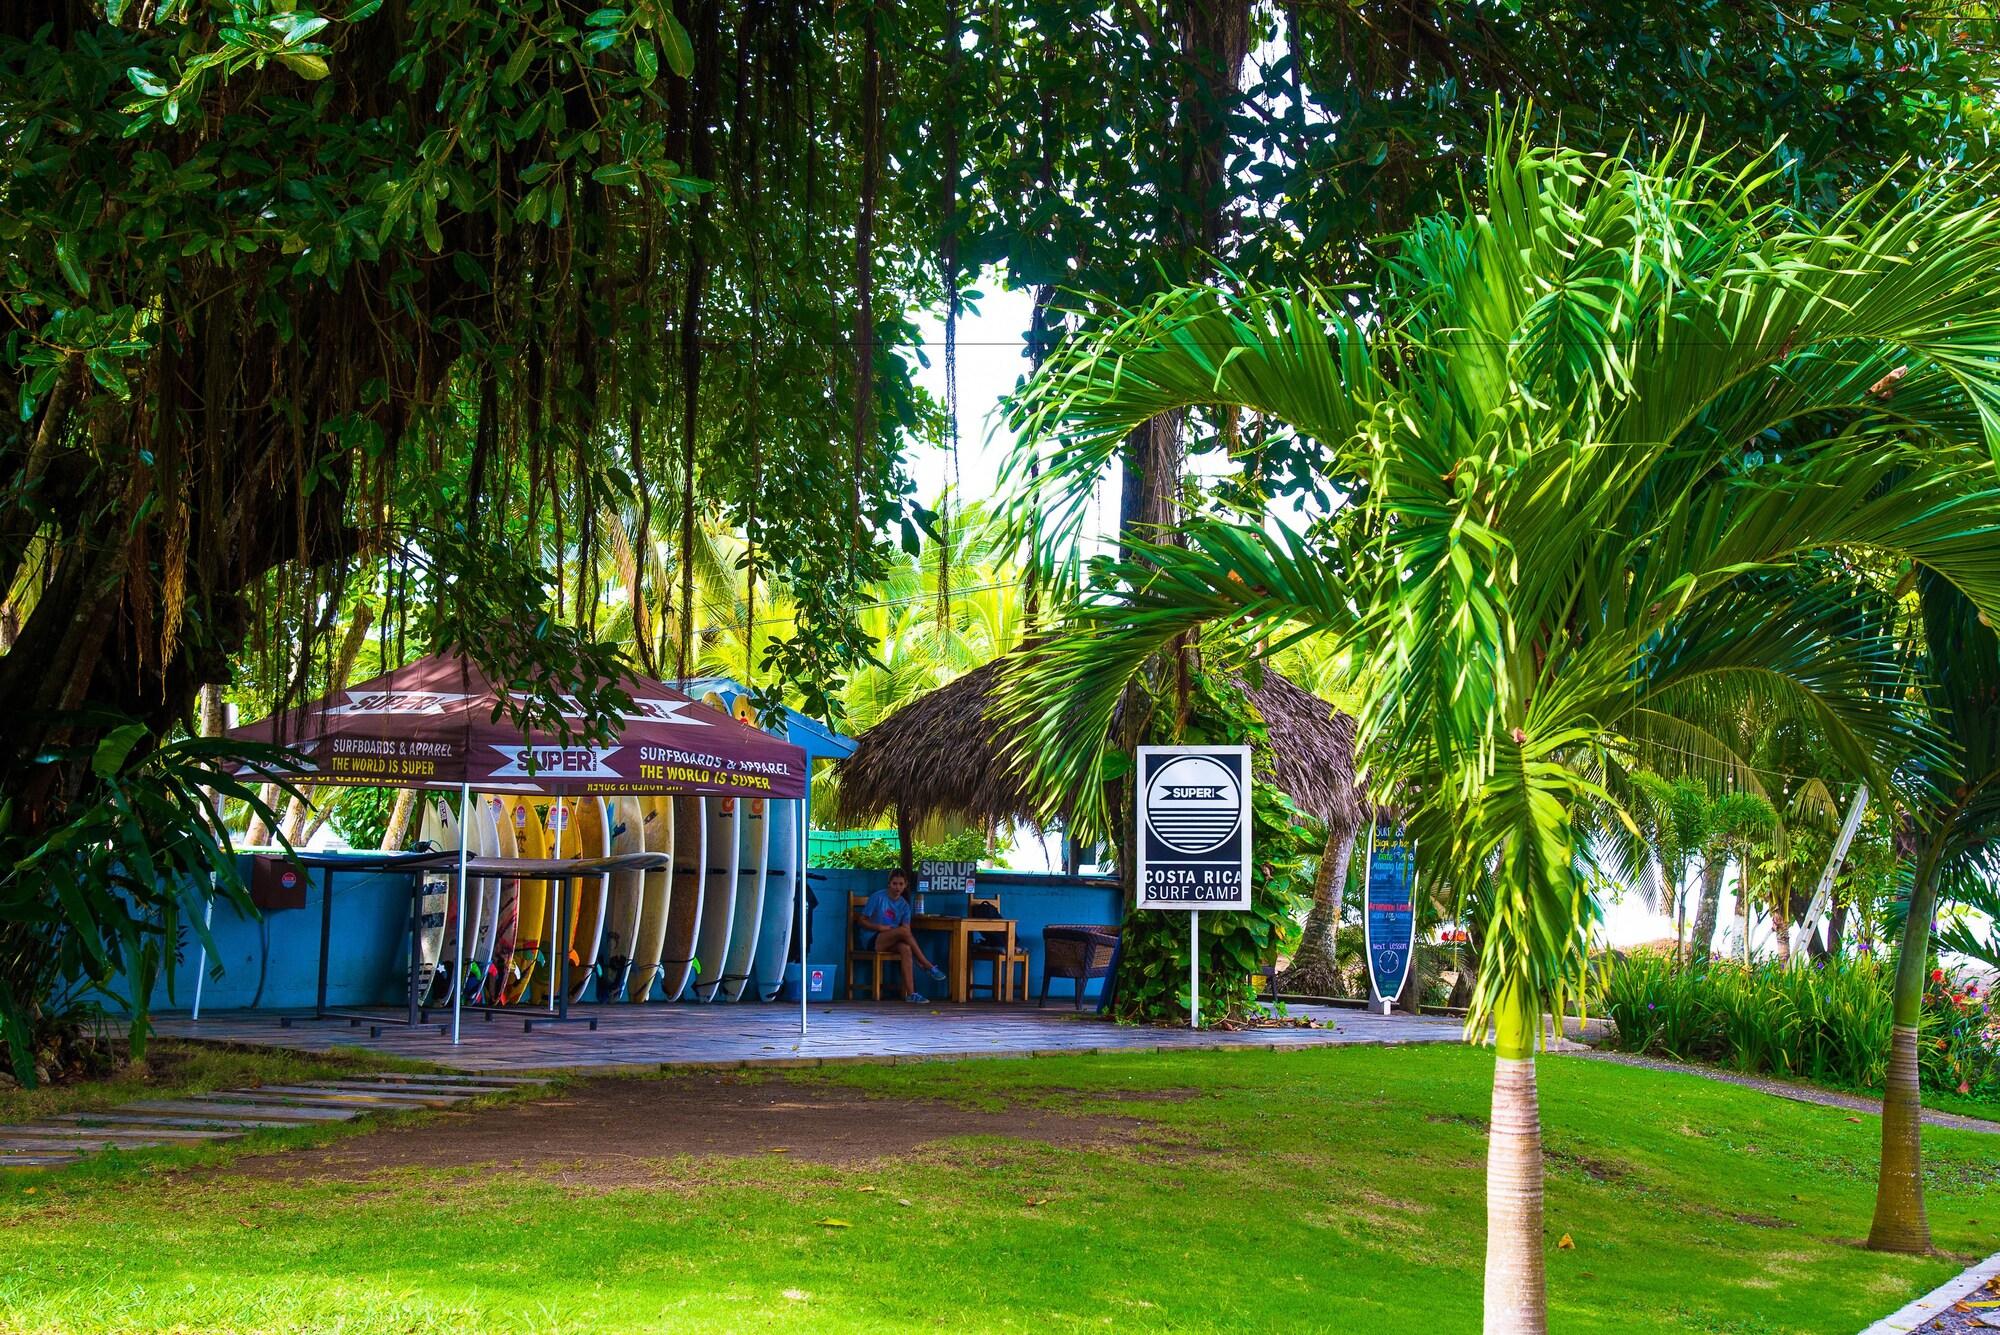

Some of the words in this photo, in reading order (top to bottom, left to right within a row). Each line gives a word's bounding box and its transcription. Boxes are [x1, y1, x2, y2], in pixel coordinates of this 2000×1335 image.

[350, 695, 438, 711] SUPER
[333, 739, 396, 755] SURFBOARDS
[400, 742, 407, 755] &
[409, 742, 452, 757] APPAREL
[332, 757, 350, 771] THE
[352, 758, 386, 773] WORLD
[388, 759, 399, 774] IS
[402, 760, 434, 775] SUPER
[517, 750, 592, 772] SUPER
[640, 746, 722, 769] SURFBOARDS
[726, 759, 736, 770] &
[739, 760, 791, 776] APPAREL
[640, 764, 664, 779] THE
[666, 767, 710, 783] WORLD
[714, 771, 728, 785] IS
[731, 774, 772, 790] SUPER
[1173, 787, 1211, 798] SUPER
[922, 861, 954, 876] SIGN
[957, 862, 975, 877] UP
[1145, 870, 1196, 884] COSTA
[1204, 870, 1241, 884] RICA
[931, 876, 966, 891] HERE
[1148, 886, 1190, 900] SURF
[1195, 886, 1239, 900] CAMP
